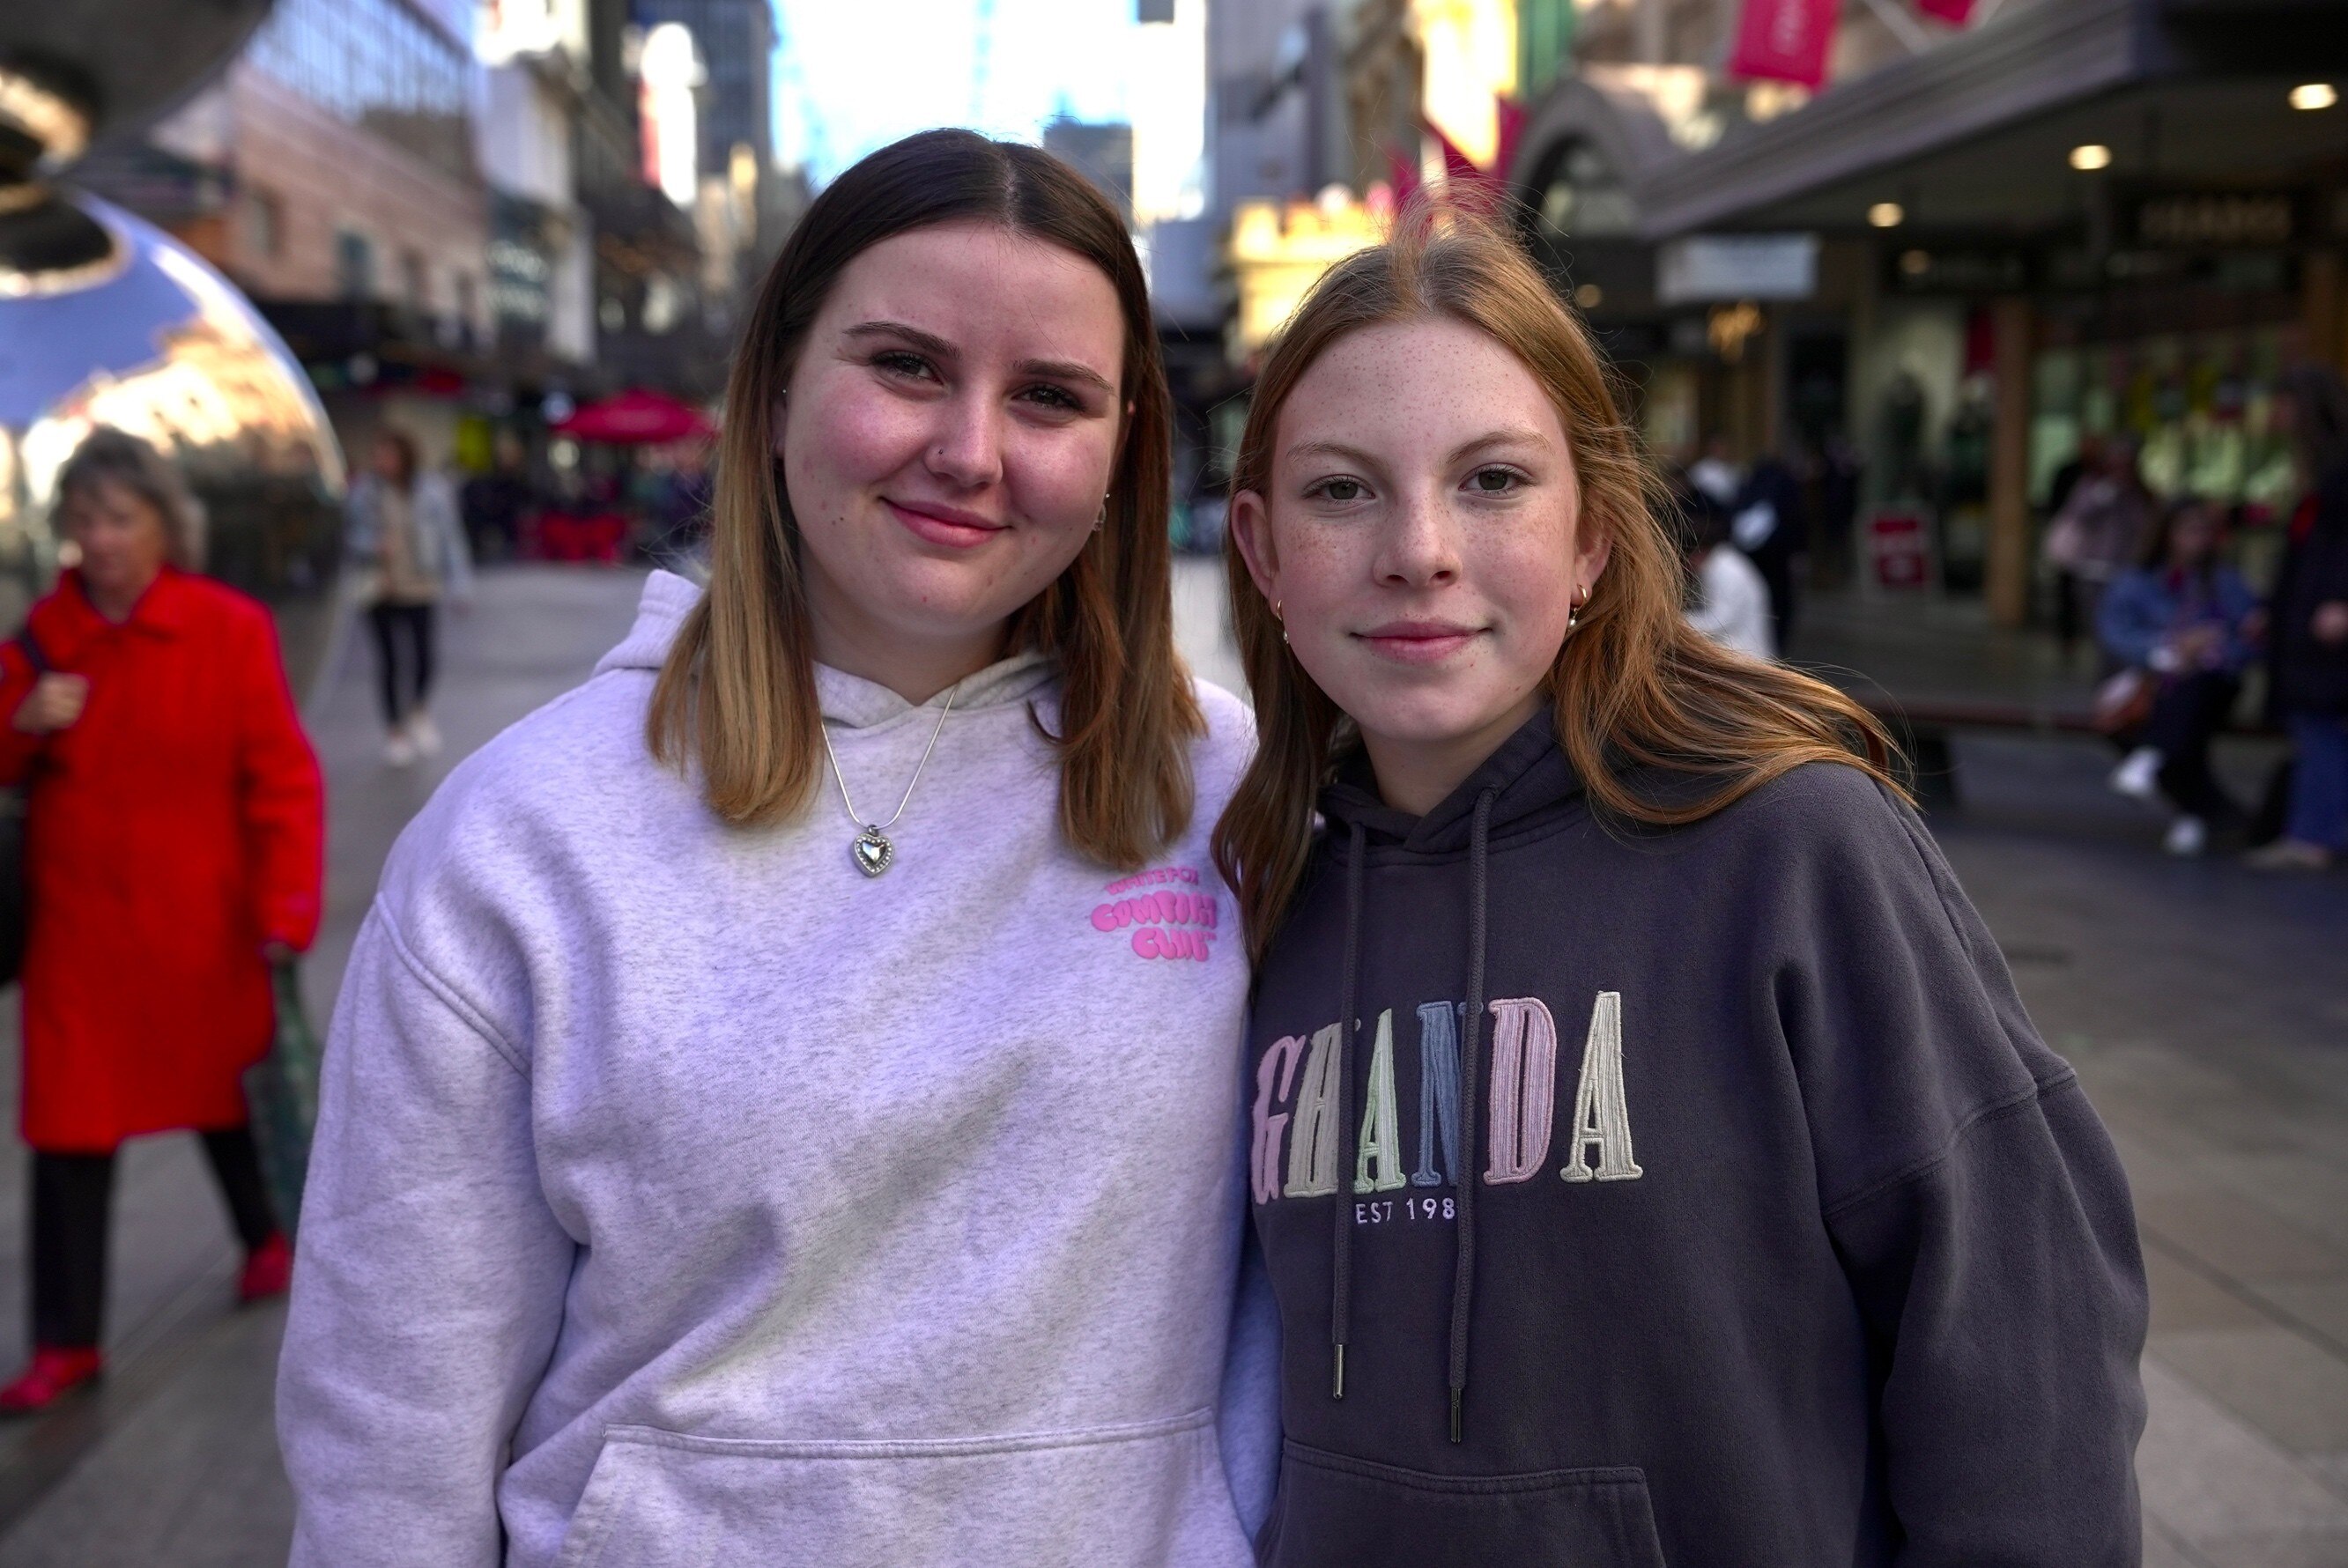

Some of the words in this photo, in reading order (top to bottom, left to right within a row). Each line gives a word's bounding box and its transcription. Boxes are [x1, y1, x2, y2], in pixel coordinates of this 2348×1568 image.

[1131, 927, 1209, 961] CLUB
[1355, 1201, 1394, 1224] EST
[1406, 1197, 1456, 1220] 198
